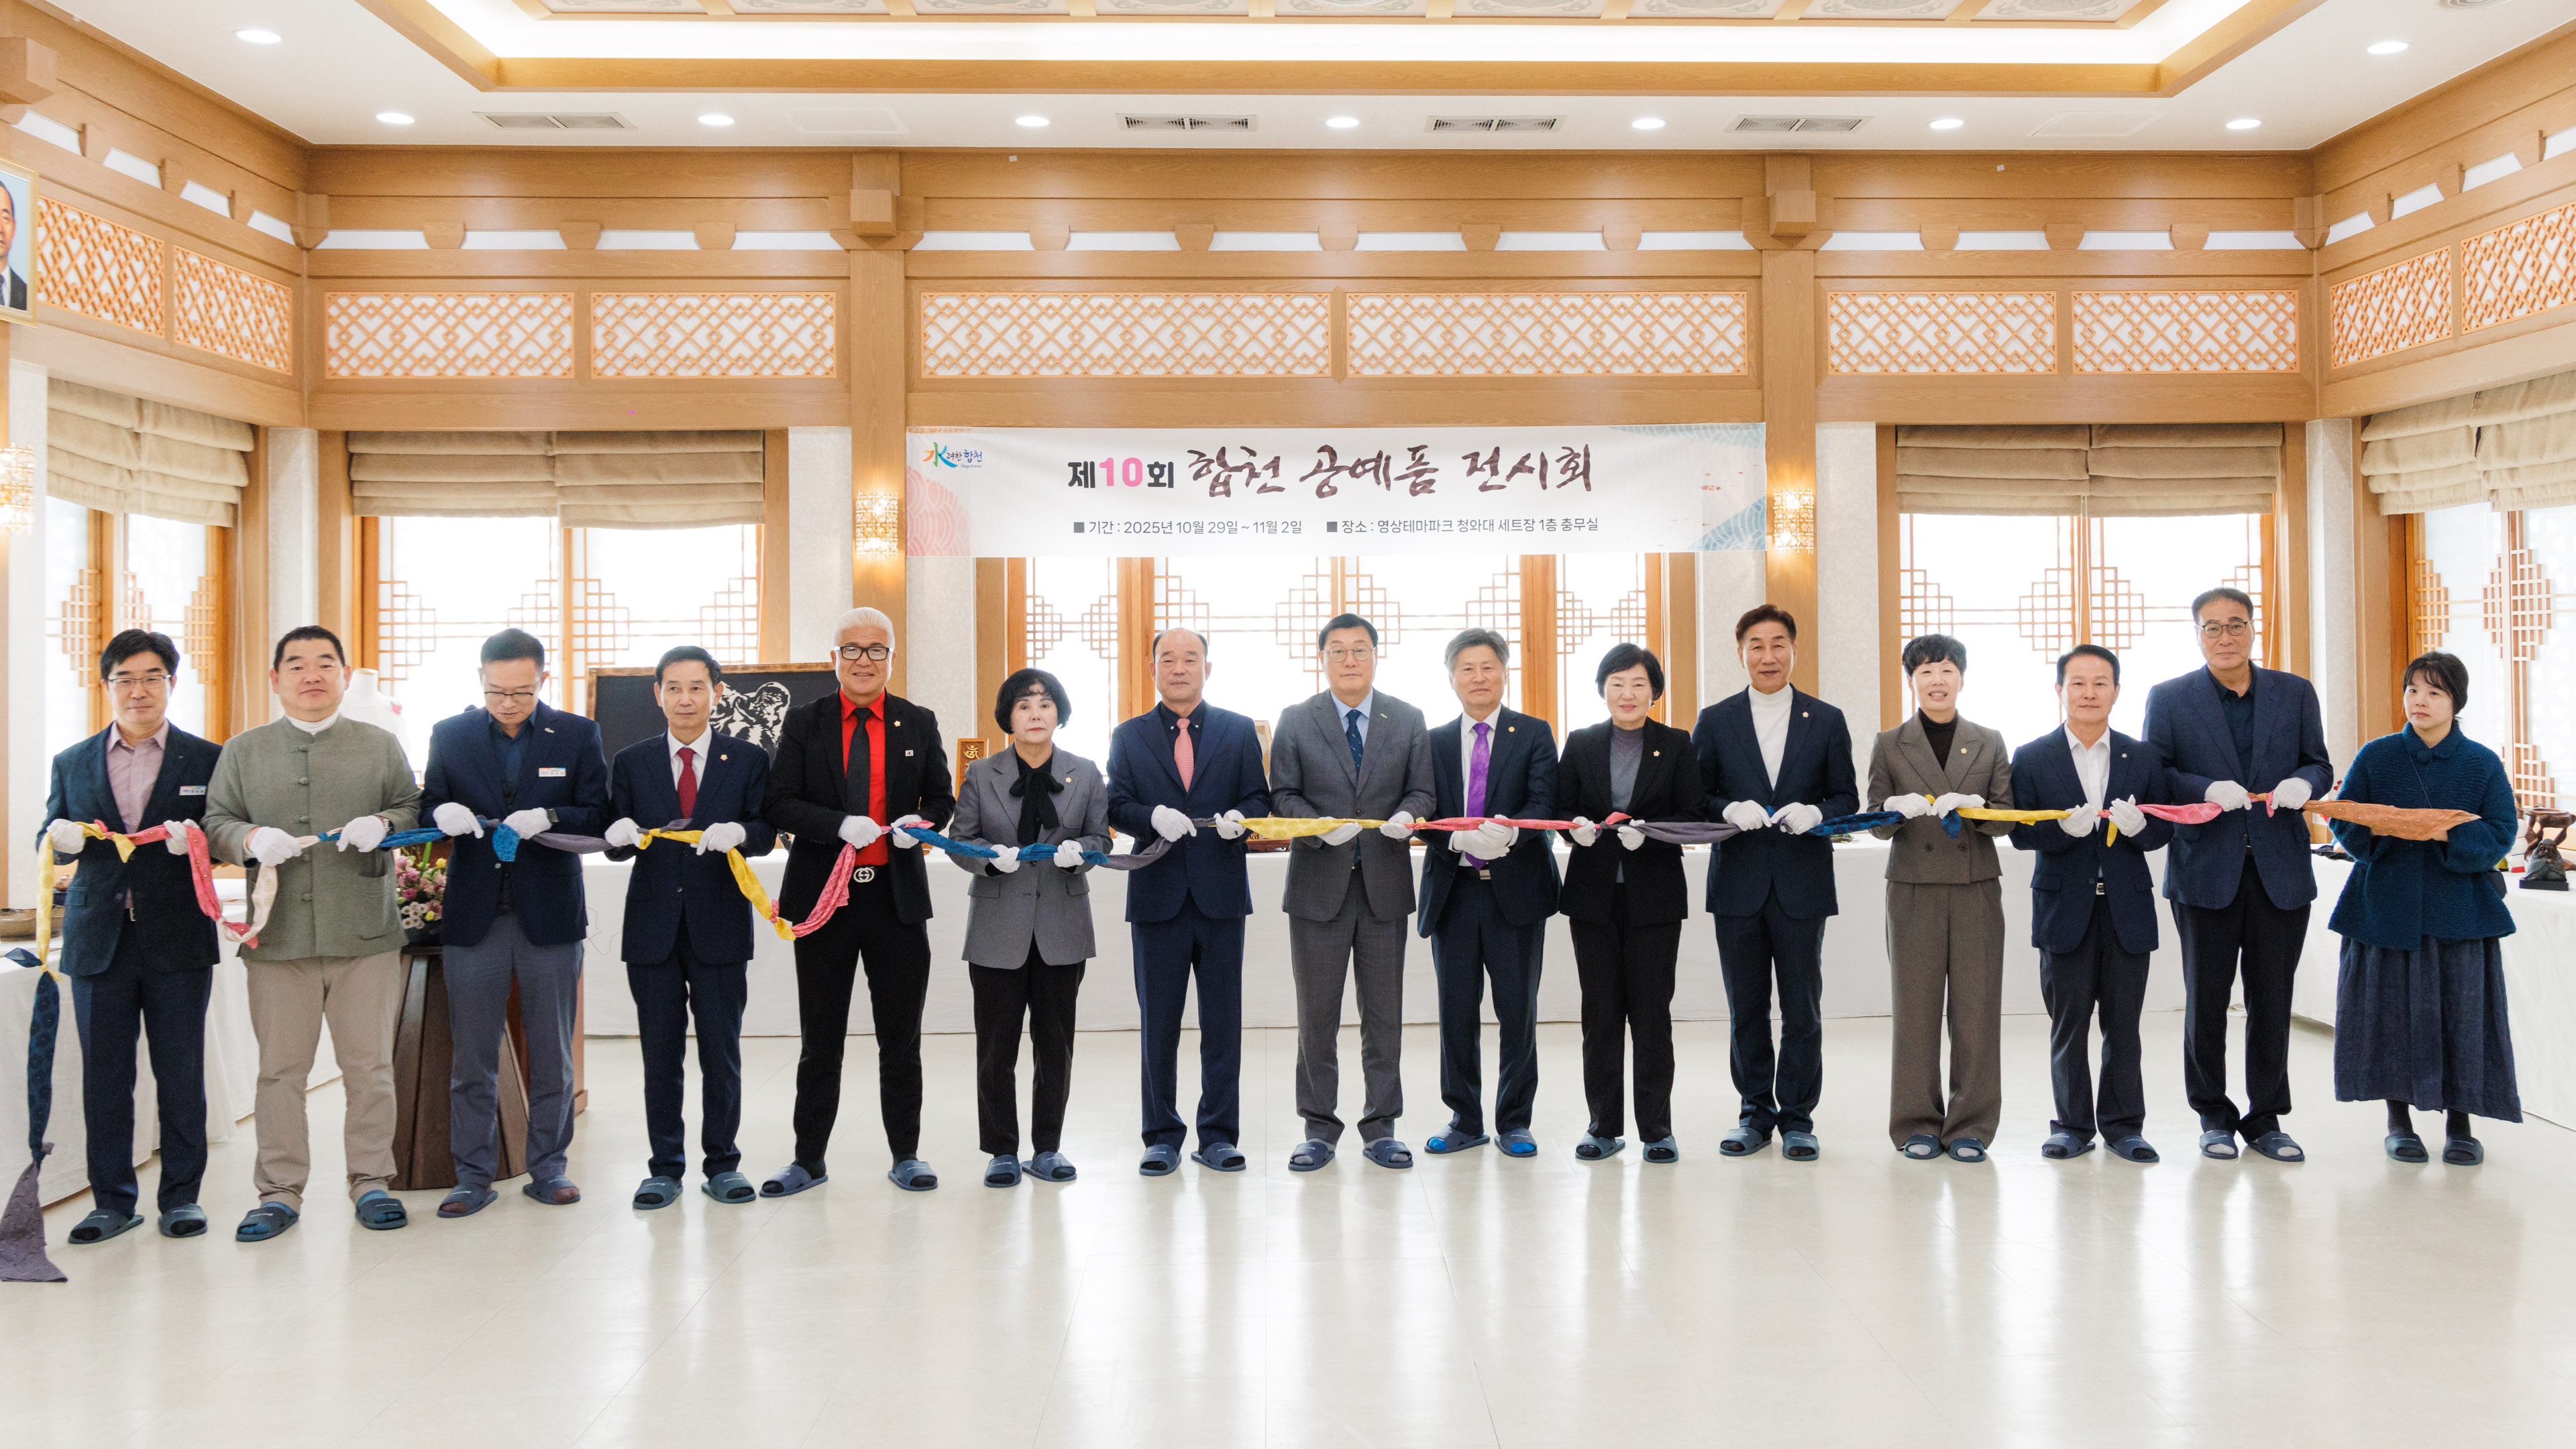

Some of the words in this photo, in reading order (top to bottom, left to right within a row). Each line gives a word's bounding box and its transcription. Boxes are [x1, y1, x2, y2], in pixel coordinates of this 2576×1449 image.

[963, 449, 983, 464] 합천
[1068, 458, 1174, 489] 제10회
[1187, 446, 1285, 498] 합천
[1299, 445, 1439, 499] 공예품
[1462, 444, 1592, 493] 전시회
[1089, 521, 1114, 535] 기간
[1124, 521, 1173, 535] 2025년
[1176, 521, 1204, 535] 10월
[1208, 521, 1238, 535] 29일
[1252, 521, 1278, 535] 11월
[1281, 520, 1302, 535] 2일
[1342, 520, 1368, 534] 장소
[1377, 519, 1454, 533] 영상테마파크
[1457, 519, 1494, 533] 청와대
[1498, 518, 1536, 532] 세트장
[1538, 518, 1558, 532] 1층
[1560, 517, 1599, 532] 충무실
